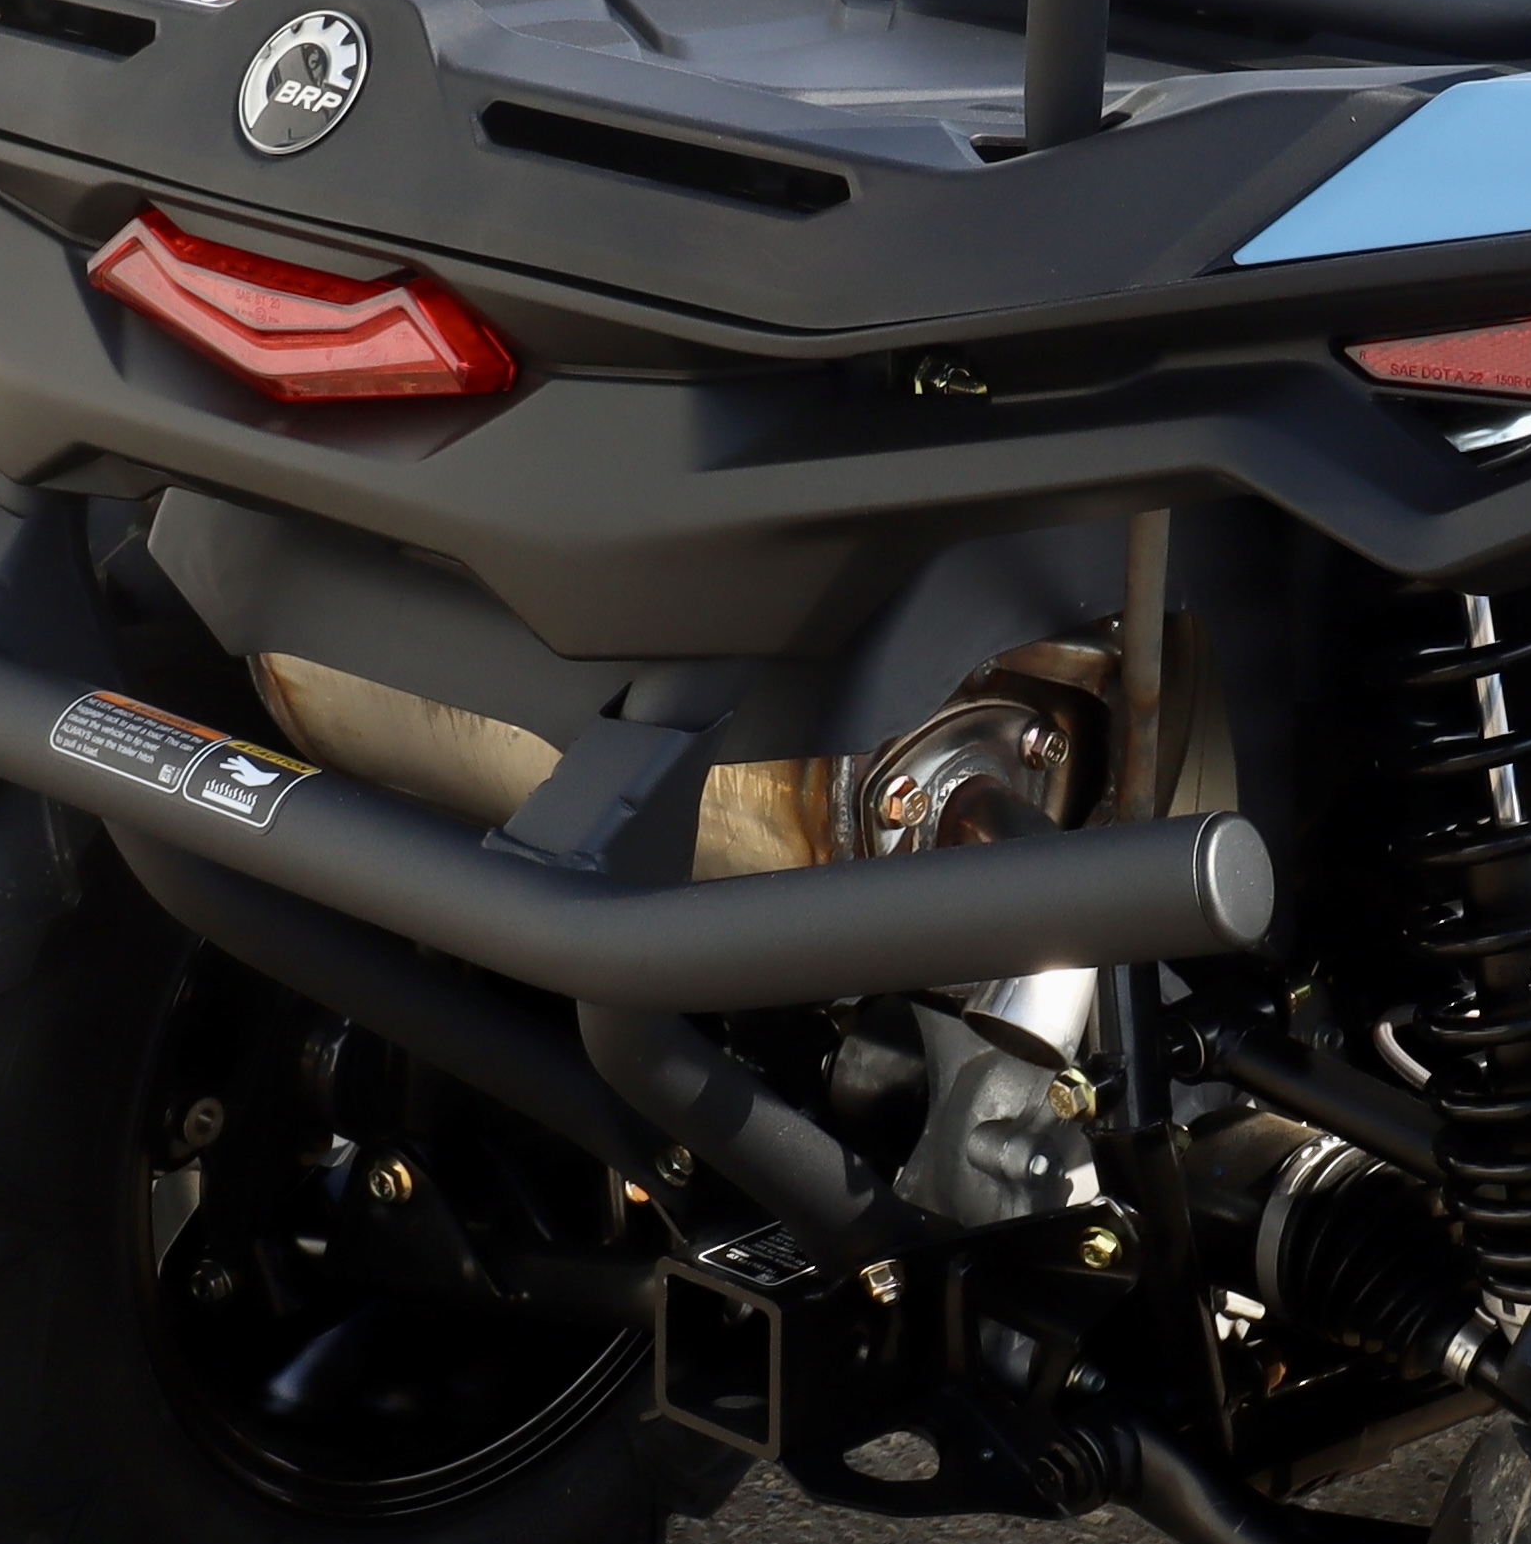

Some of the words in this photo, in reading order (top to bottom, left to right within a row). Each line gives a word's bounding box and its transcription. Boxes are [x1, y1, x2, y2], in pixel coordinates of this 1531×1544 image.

[274, 79, 343, 112] BRP
[1390, 363, 1418, 377] SAE
[1422, 366, 1451, 381] DOT
[1454, 369, 1464, 382] A
[1467, 371, 1484, 385] 22
[1495, 374, 1523, 387] 150R
[55, 734, 63, 744] to
[63, 738, 76, 748] pull
[68, 713, 90, 725] cause
[88, 719, 102, 730] the
[101, 723, 126, 739] vehicle
[124, 732, 134, 742] to
[76, 704, 104, 720] luggage
[103, 713, 120, 724] rack
[164, 735, 180, 747] This
[179, 742, 194, 752] can
[60, 722, 92, 740] ALWAYS
[91, 735, 105, 745] use
[104, 738, 117, 750] the
[117, 743, 139, 757] trailer
[136, 749, 155, 764] hitch
[248, 745, 311, 771] CAUTION
